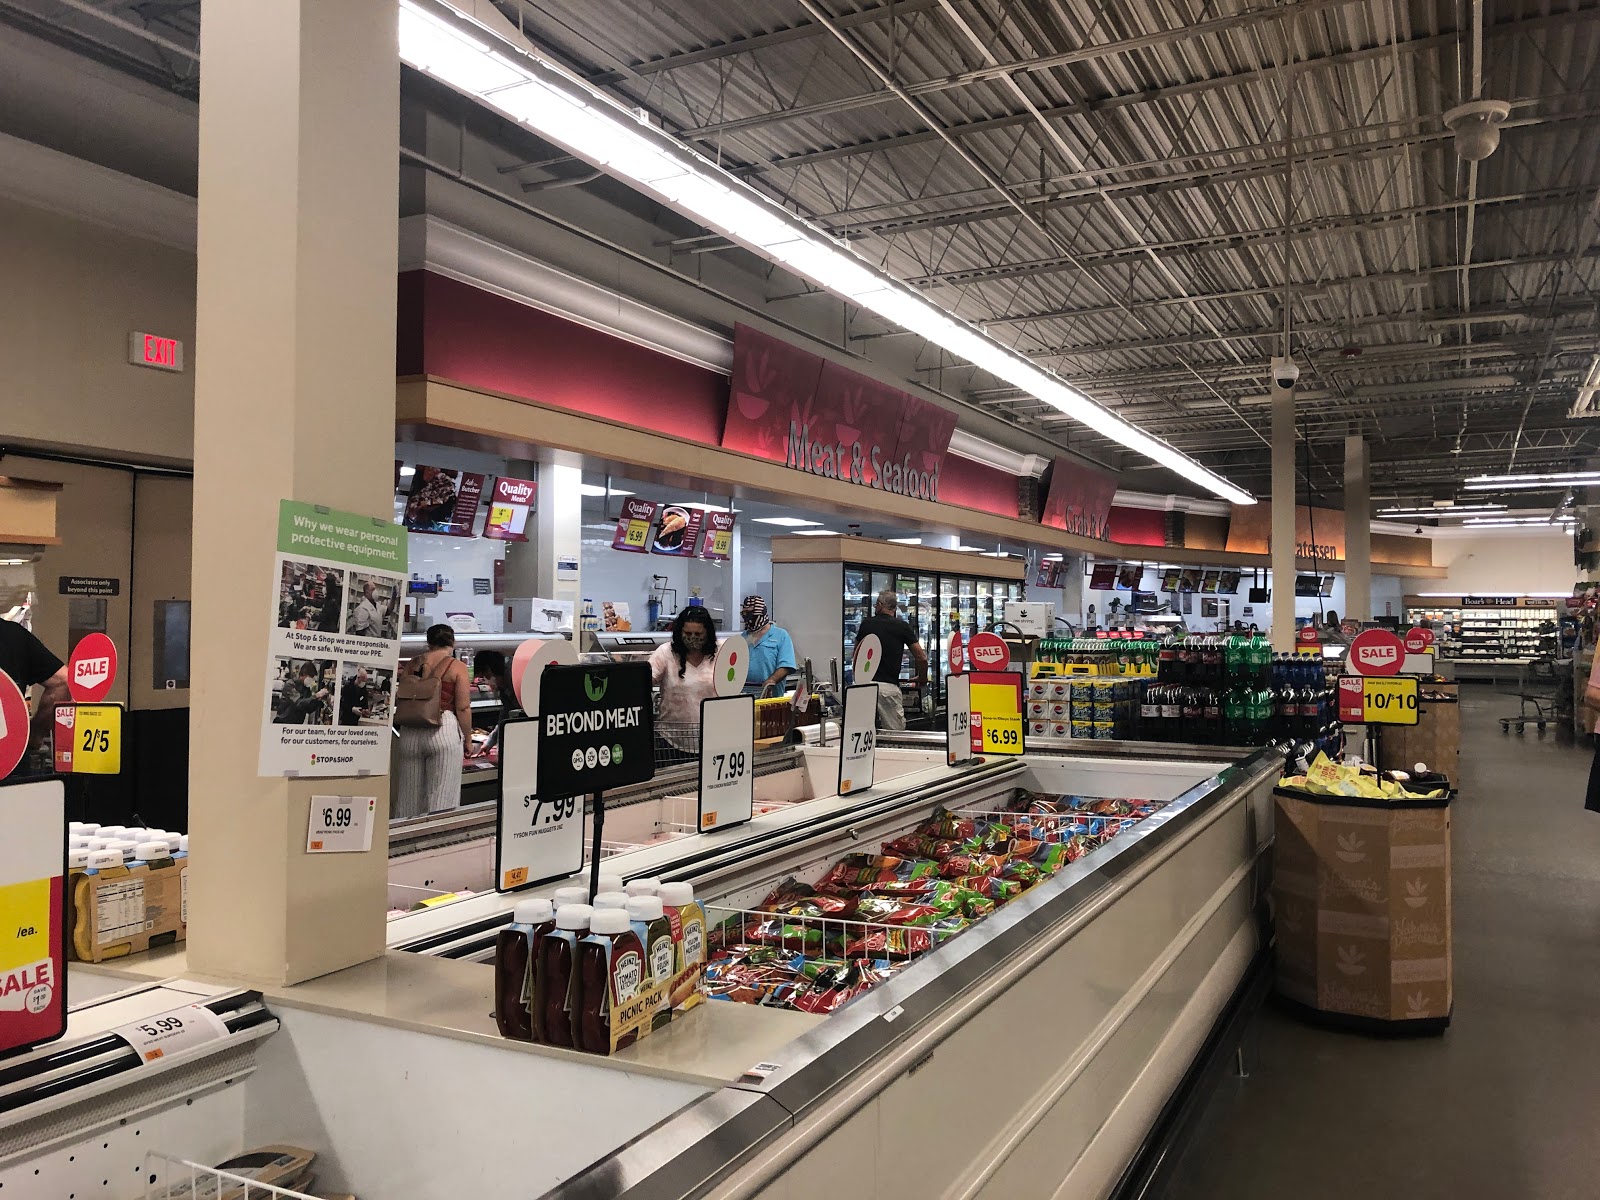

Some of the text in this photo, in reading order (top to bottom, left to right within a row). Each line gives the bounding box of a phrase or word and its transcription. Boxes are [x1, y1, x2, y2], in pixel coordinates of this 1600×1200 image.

[144, 334, 176, 367] EXIT
[787, 421, 938, 502] Meat & Seafood
[500, 482, 532, 498] Quality
[510, 495, 526, 503] Meats
[628, 501, 654, 516] Quality
[712, 514, 733, 526] Quality
[1066, 505, 1088, 536] Grab
[293, 515, 398, 546] Why we wear personal
[292, 533, 399, 560] protective equipment.
[1296, 540, 1337, 560] atessen
[286, 632, 294, 640] At
[296, 632, 311, 642] Stop
[319, 635, 335, 644] Shop
[357, 640, 390, 649] responsible.
[294, 642, 304, 650] We
[317, 644, 332, 652] safe.
[371, 649, 383, 657] PPE.
[952, 649, 960, 658] SALE
[976, 648, 1001, 656] SALE
[1361, 648, 1394, 658] SALE
[76, 660, 106, 677] SALE
[1365, 693, 1417, 709] 10/$10
[56, 708, 73, 717] SALE
[546, 706, 640, 736] BEYOND MEAT
[308, 728, 326, 736] team,
[327, 728, 336, 736] for
[987, 729, 1017, 744] $6.99
[83, 729, 109, 752] 2/$5
[305, 738, 340, 746] customers,
[351, 738, 378, 746] ourselves.
[851, 730, 873, 753] $7.99
[713, 751, 744, 780] $7.99
[322, 808, 351, 827] $6.99
[524, 795, 575, 826] $7.99
[538, 826, 557, 835] NUGGETS
[17, 926, 38, 938] /ea.
[687, 925, 698, 936] HEINZ
[656, 942, 668, 952] HEINZ
[686, 942, 700, 954] MUSTARD
[620, 958, 634, 970] HEINZ
[657, 960, 669, 971] RELISH
[0, 963, 49, 997] ALE
[619, 969, 637, 982] TOMATO
[620, 978, 637, 990] KETCHUP
[640, 982, 652, 993] HEINZ
[620, 990, 662, 1024] PICNIC PACK
[136, 1017, 183, 1036] $5.99
